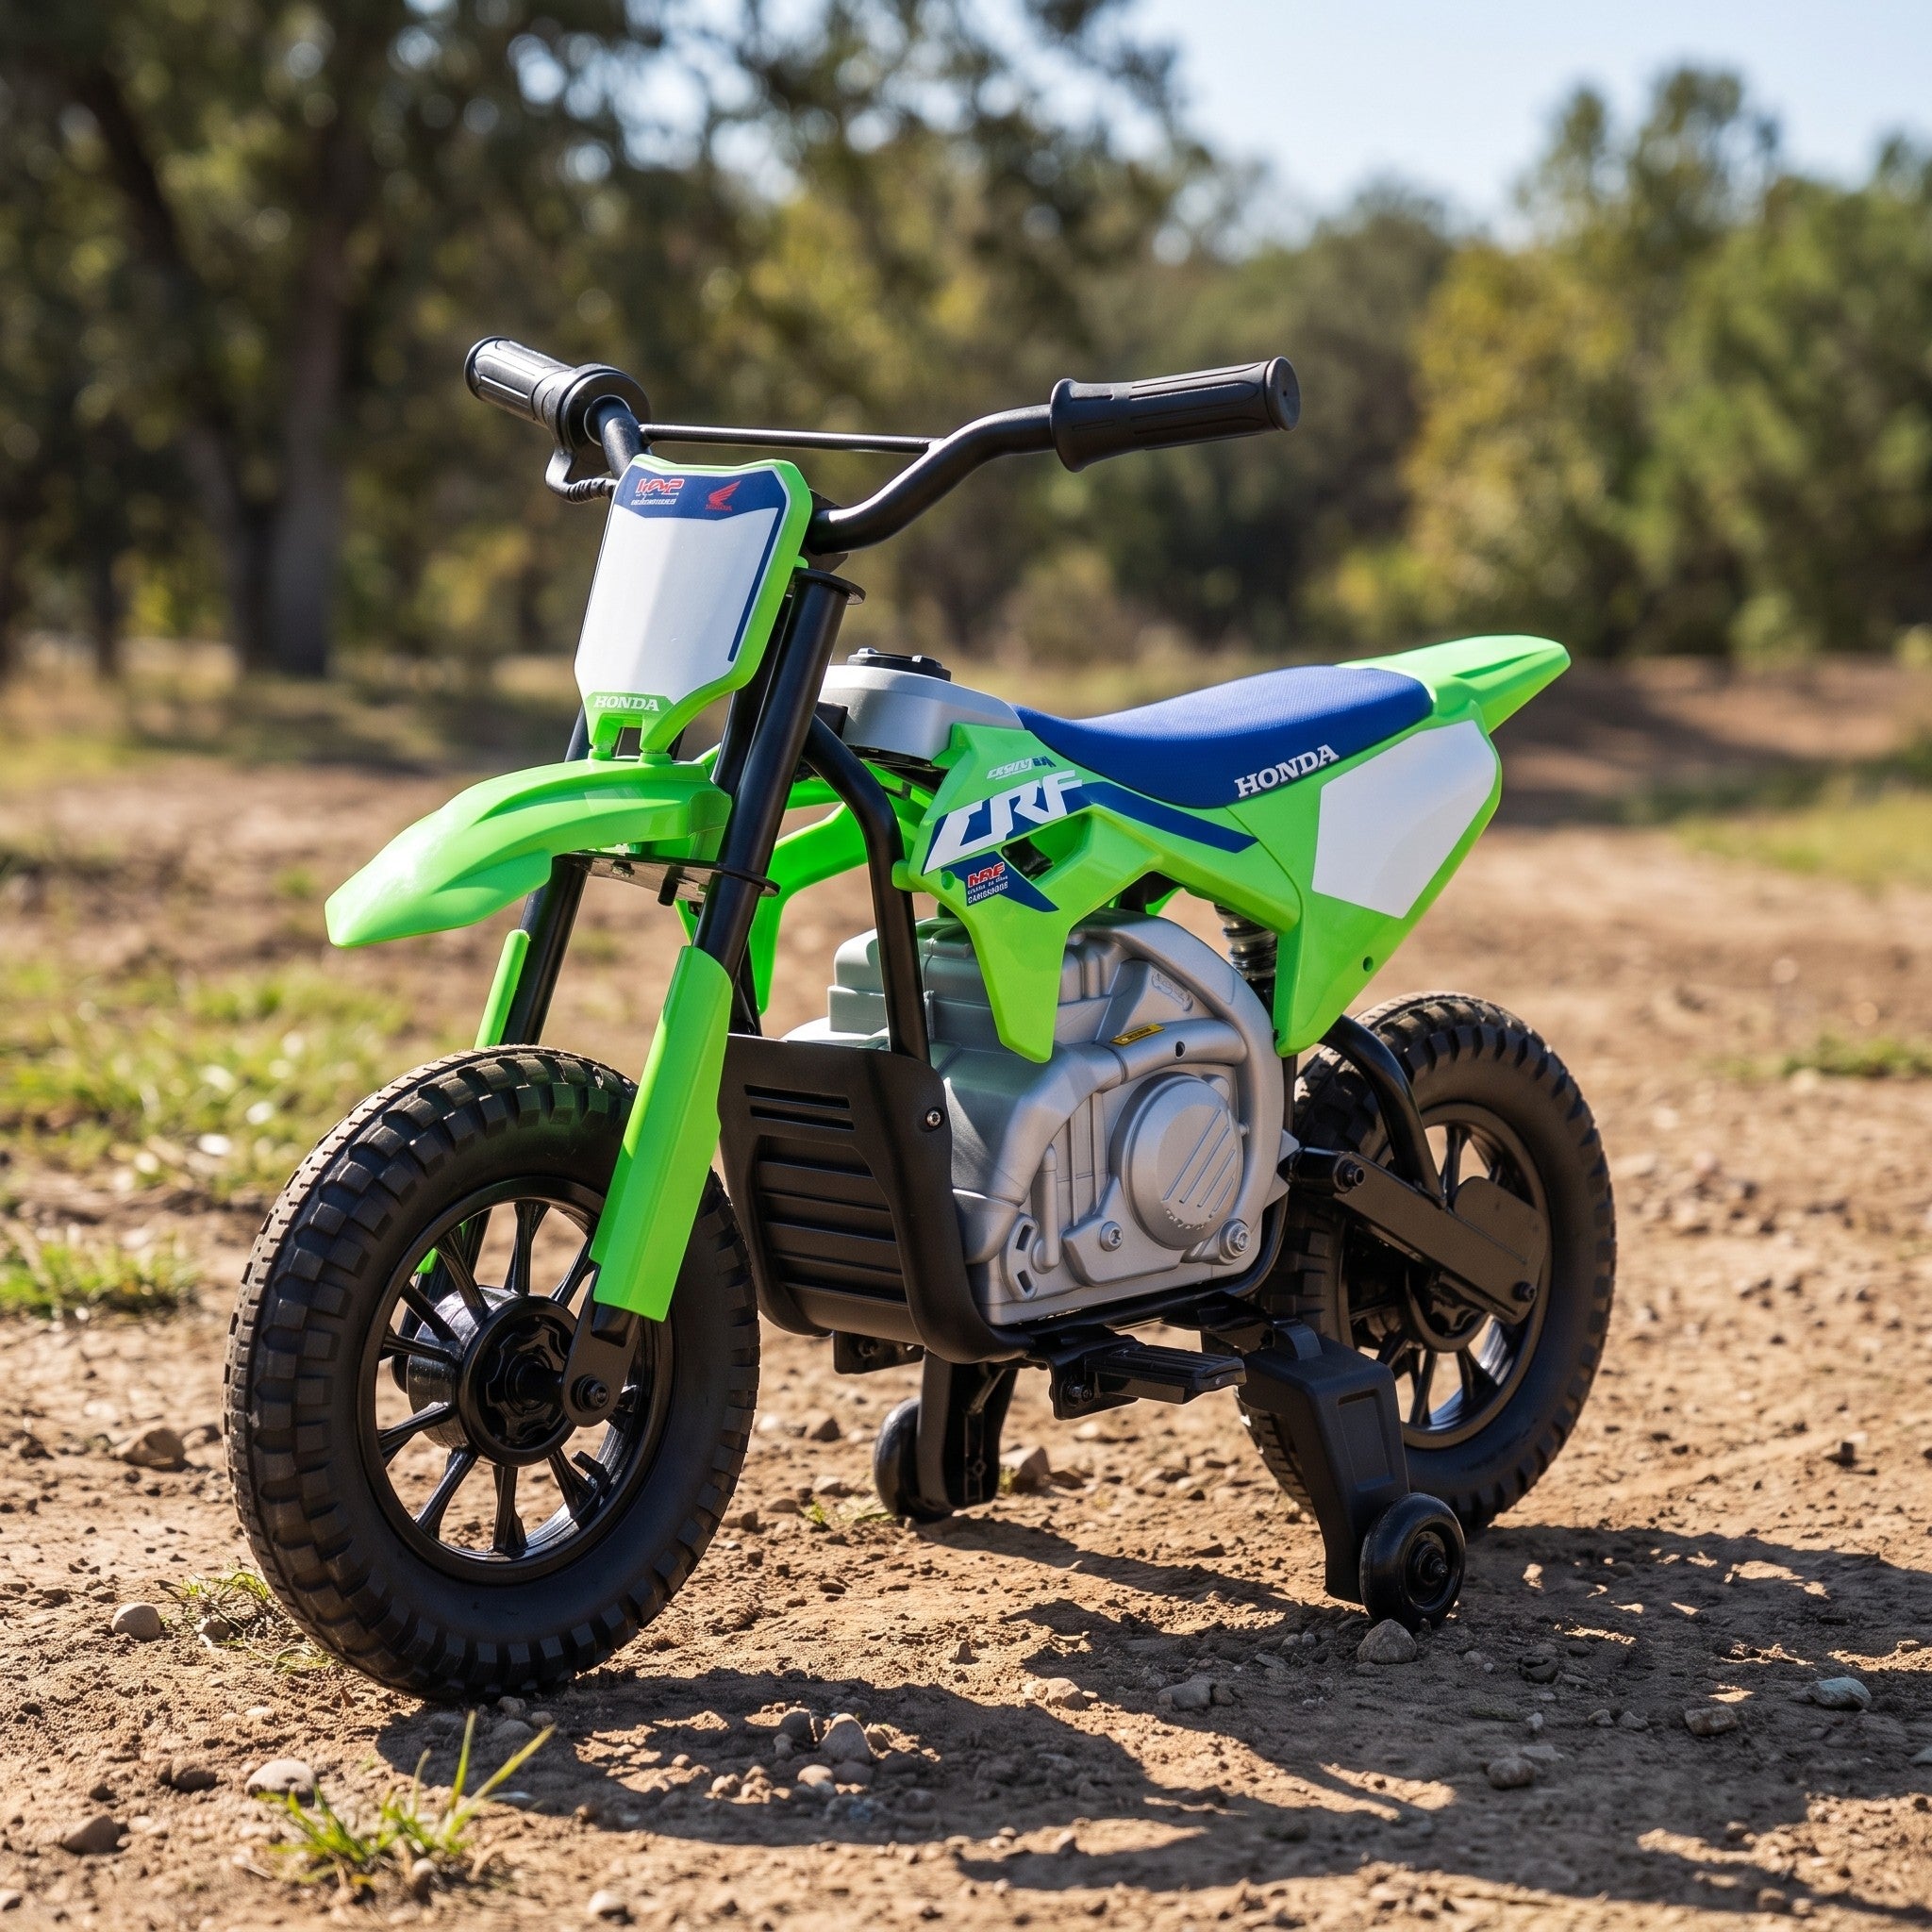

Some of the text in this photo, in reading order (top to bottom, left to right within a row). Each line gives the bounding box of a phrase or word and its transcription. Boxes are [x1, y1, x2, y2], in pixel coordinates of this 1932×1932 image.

[593, 695, 659, 711] HONDA
[1234, 744, 1340, 798] HONDA
[923, 770, 1083, 875] CRF
